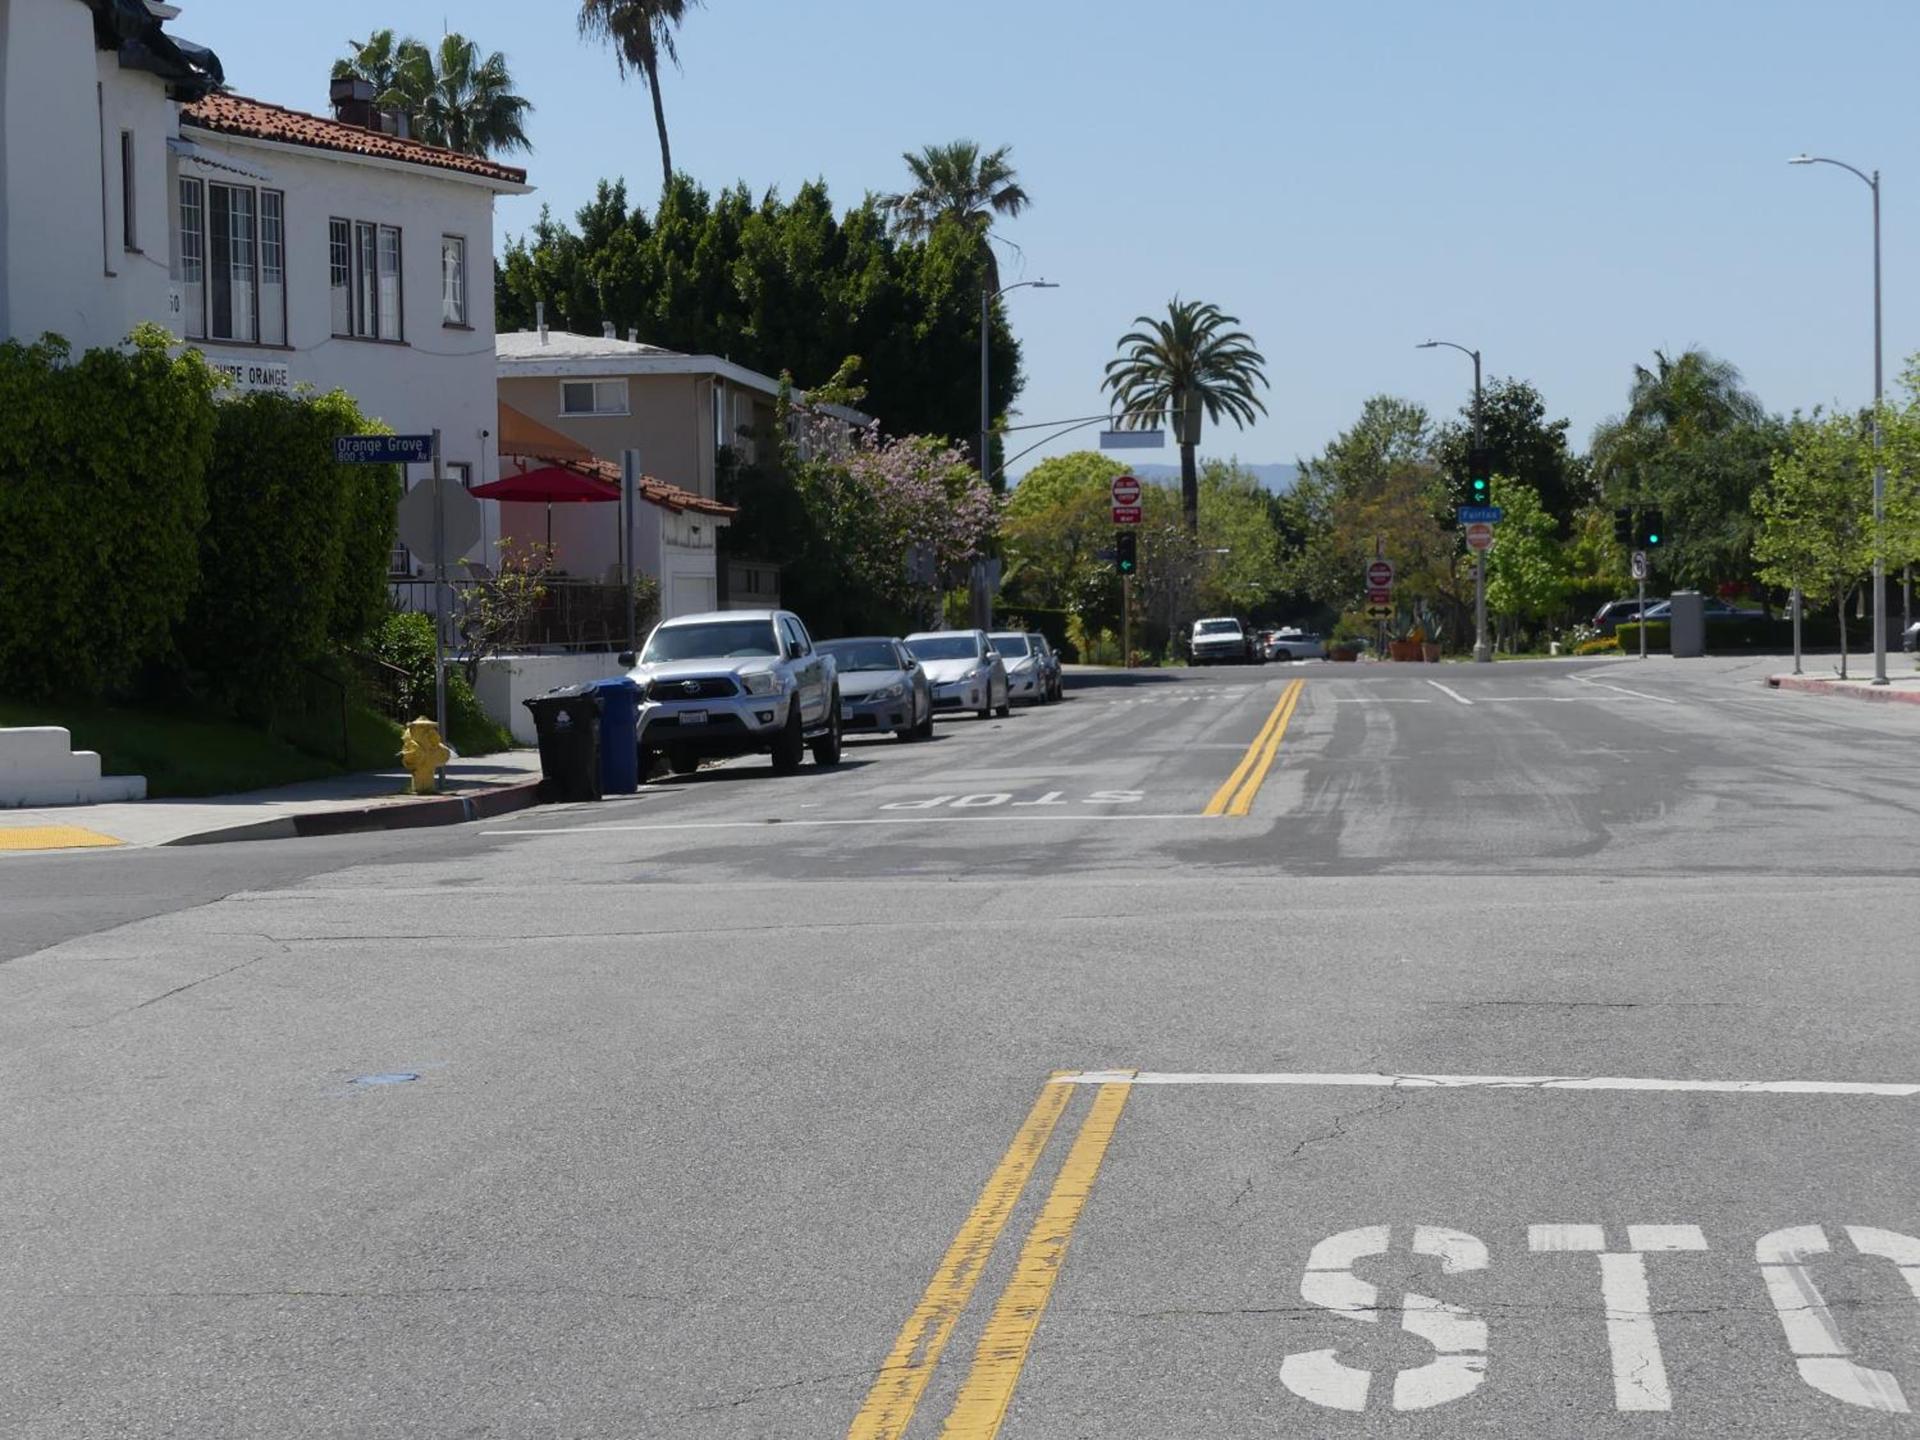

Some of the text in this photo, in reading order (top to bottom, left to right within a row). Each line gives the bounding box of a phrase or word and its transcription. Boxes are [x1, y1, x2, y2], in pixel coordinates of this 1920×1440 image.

[249, 367, 288, 386] ORANGE
[337, 437, 423, 455] Orange Grove
[1463, 510, 1498, 519] Fairfax
[879, 790, 1145, 810] STOP
